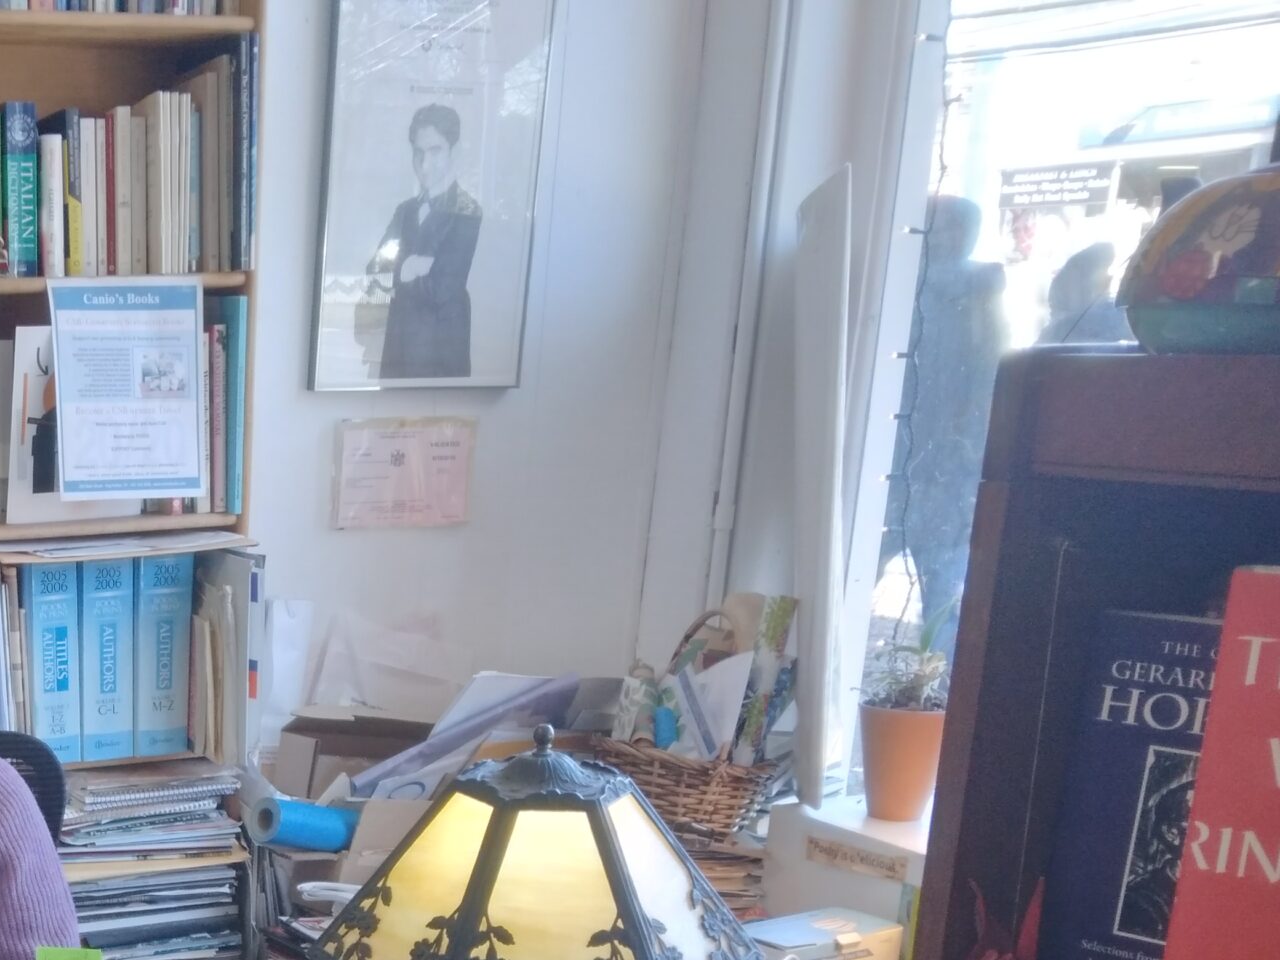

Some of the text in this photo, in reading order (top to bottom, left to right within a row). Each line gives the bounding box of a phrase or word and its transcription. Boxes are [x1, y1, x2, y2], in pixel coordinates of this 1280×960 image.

[21, 161, 35, 240] ITALIAN
[83, 293, 160, 305] Canio's Books
[41, 570, 67, 581] 2005
[95, 567, 121, 579] 2005
[154, 563, 180, 576] 2005
[40, 582, 68, 594] 2006
[94, 579, 122, 591] 2006
[153, 576, 180, 587] 2006
[160, 622, 171, 689] AUTHORS
[1161, 640, 1202, 657] THE
[43, 632, 55, 690] AUTHORS
[56, 638, 68, 680] TITLES
[103, 626, 115, 692] AUTHORS
[1081, 939, 1134, 960] Selections
